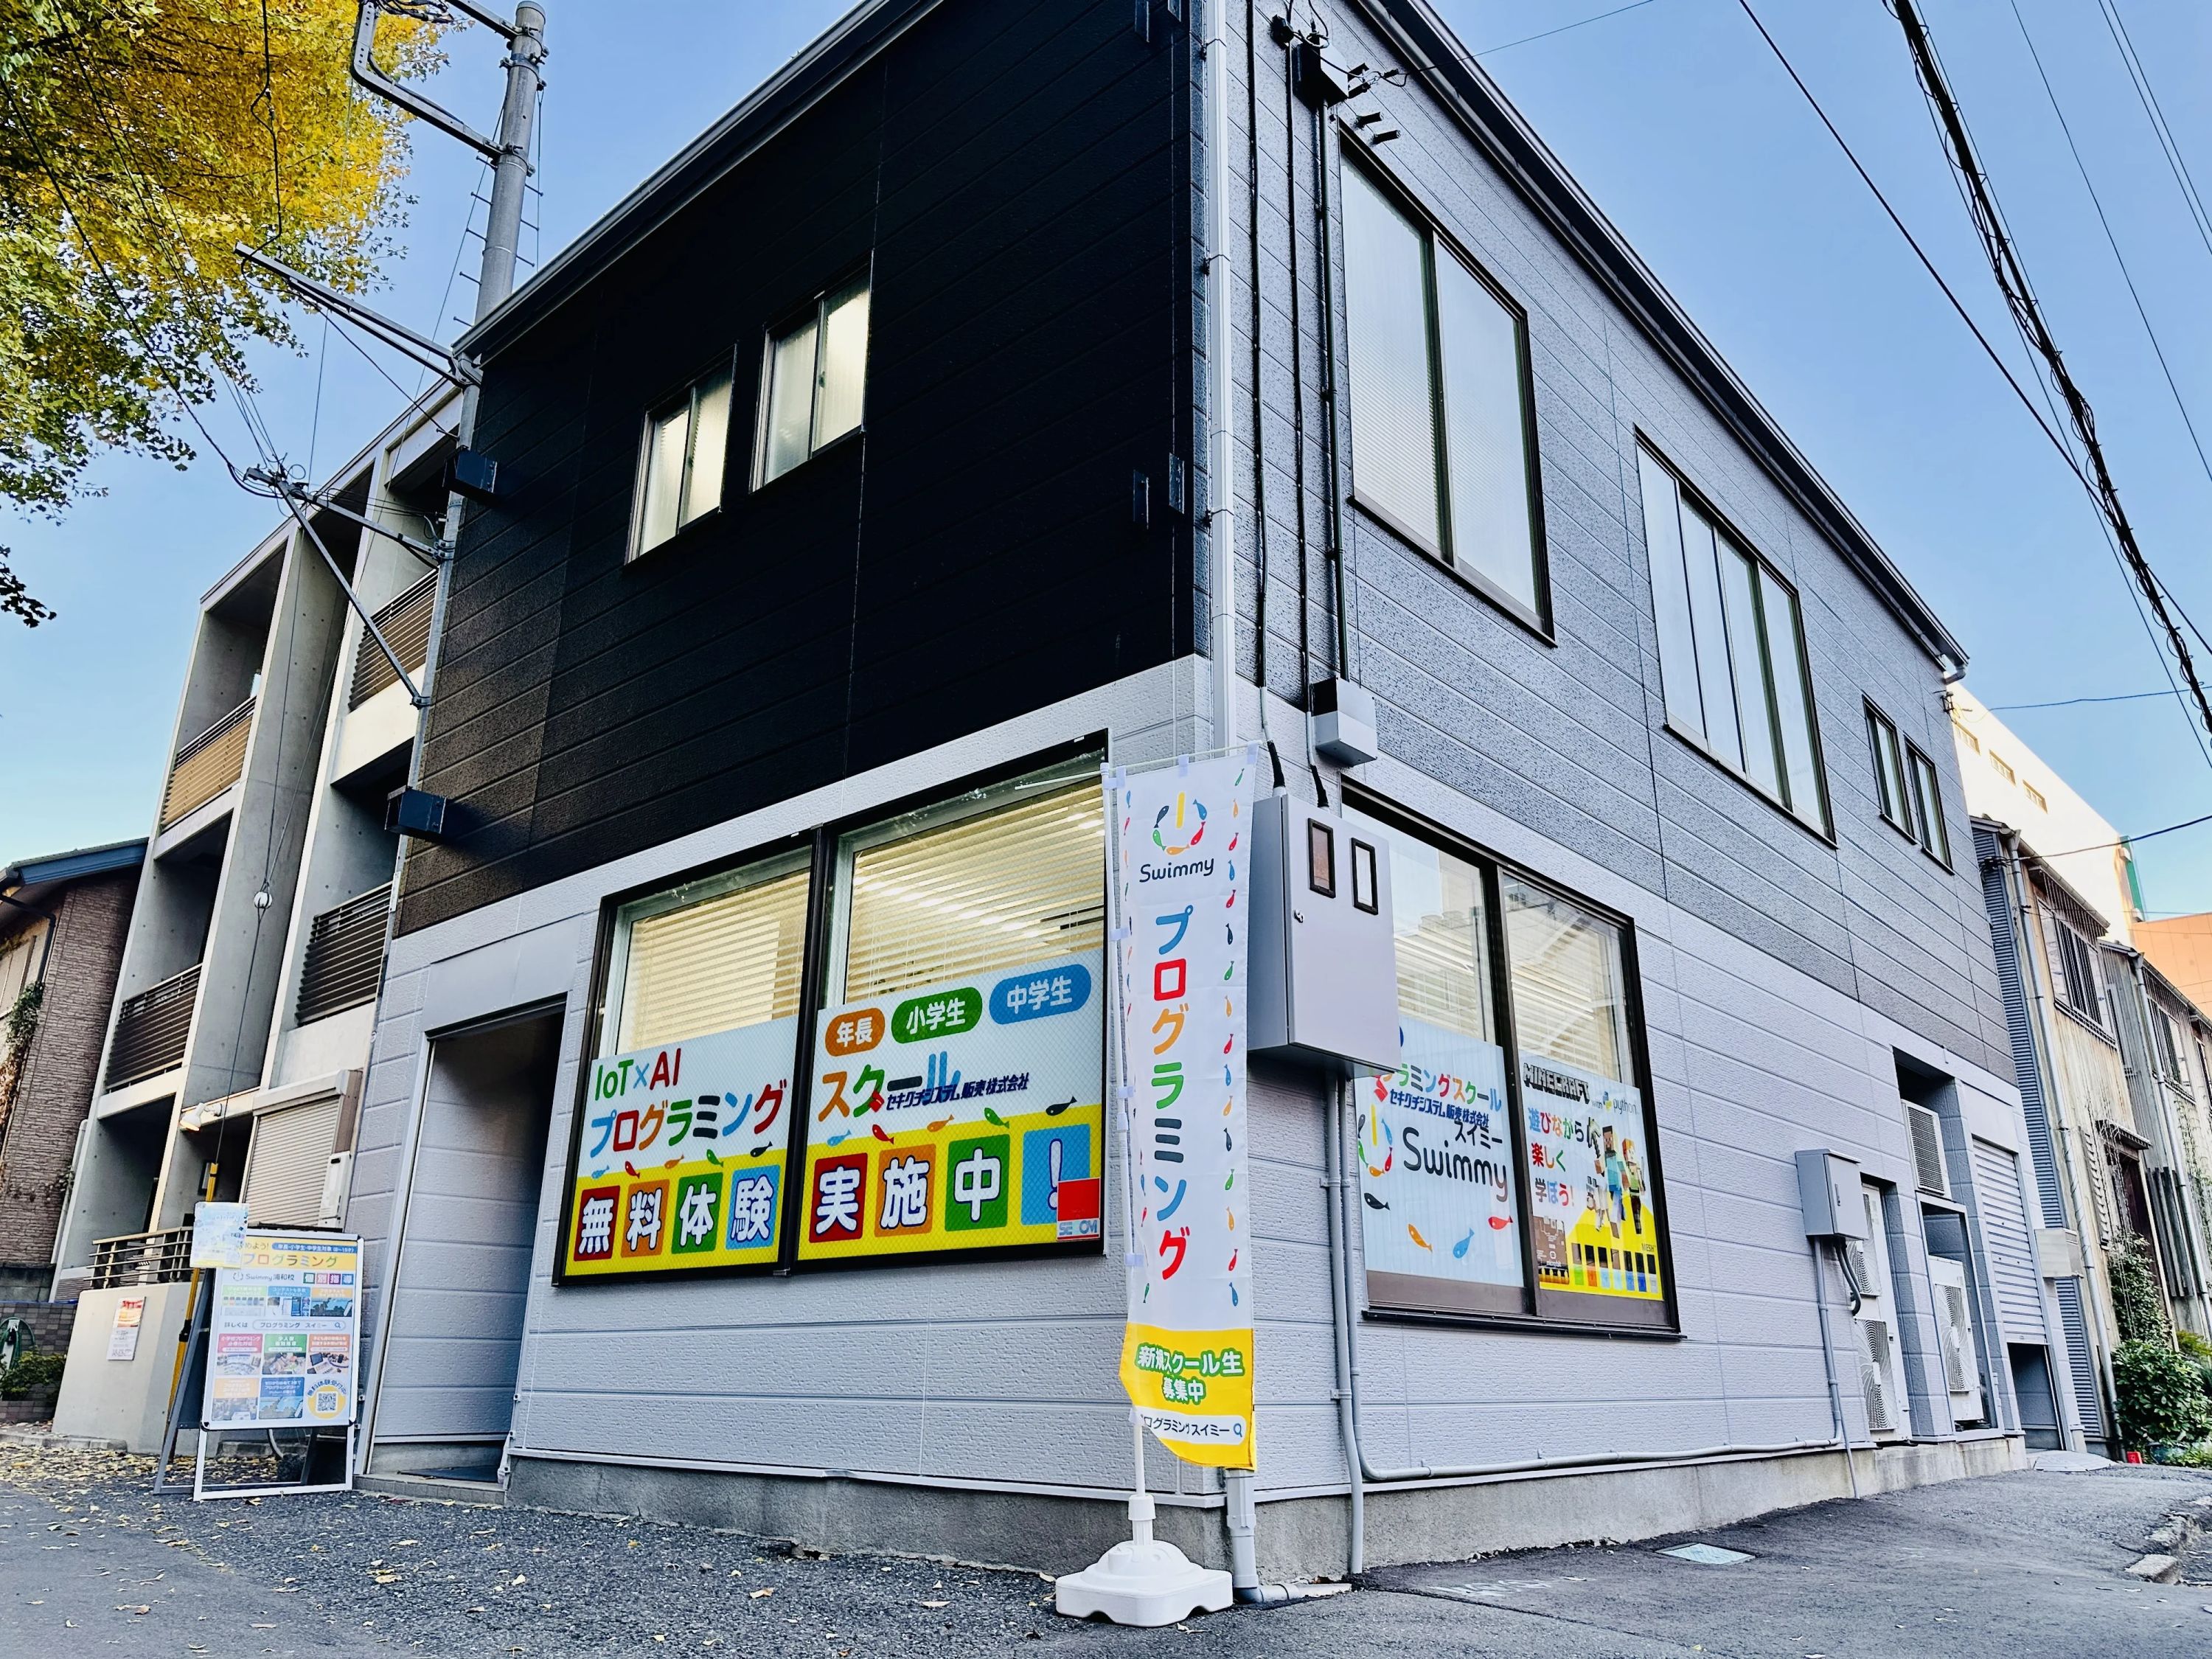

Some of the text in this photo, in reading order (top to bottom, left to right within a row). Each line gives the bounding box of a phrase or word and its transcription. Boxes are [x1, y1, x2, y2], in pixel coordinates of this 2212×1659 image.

[1139, 858, 1214, 883] Swimmy
[1006, 975, 1073, 1011] 中学生
[837, 1018, 873, 1047] 年長
[906, 998, 966, 1034] 小学生
[818, 1050, 961, 1122] スクール
[1151, 905, 1194, 1280] プログラミング
[1383, 1062, 1502, 1112] ラミングスクール
[1523, 1062, 1590, 1105] MINECRAFT
[590, 1079, 787, 1158] プログラミング
[1613, 1098, 1637, 1115] python
[1454, 1120, 1503, 1150] スイミー
[1528, 1107, 1585, 1142] 遊びながら
[1402, 1127, 1508, 1202] Swimmy
[1531, 1142, 1567, 1172] 楽しく
[1534, 1178, 1575, 1206] 学ぼう!
[578, 1173, 774, 1254] 無料体験
[1060, 1220, 1098, 1236] SEOM
[1163, 1377, 1204, 1402] 募集中
